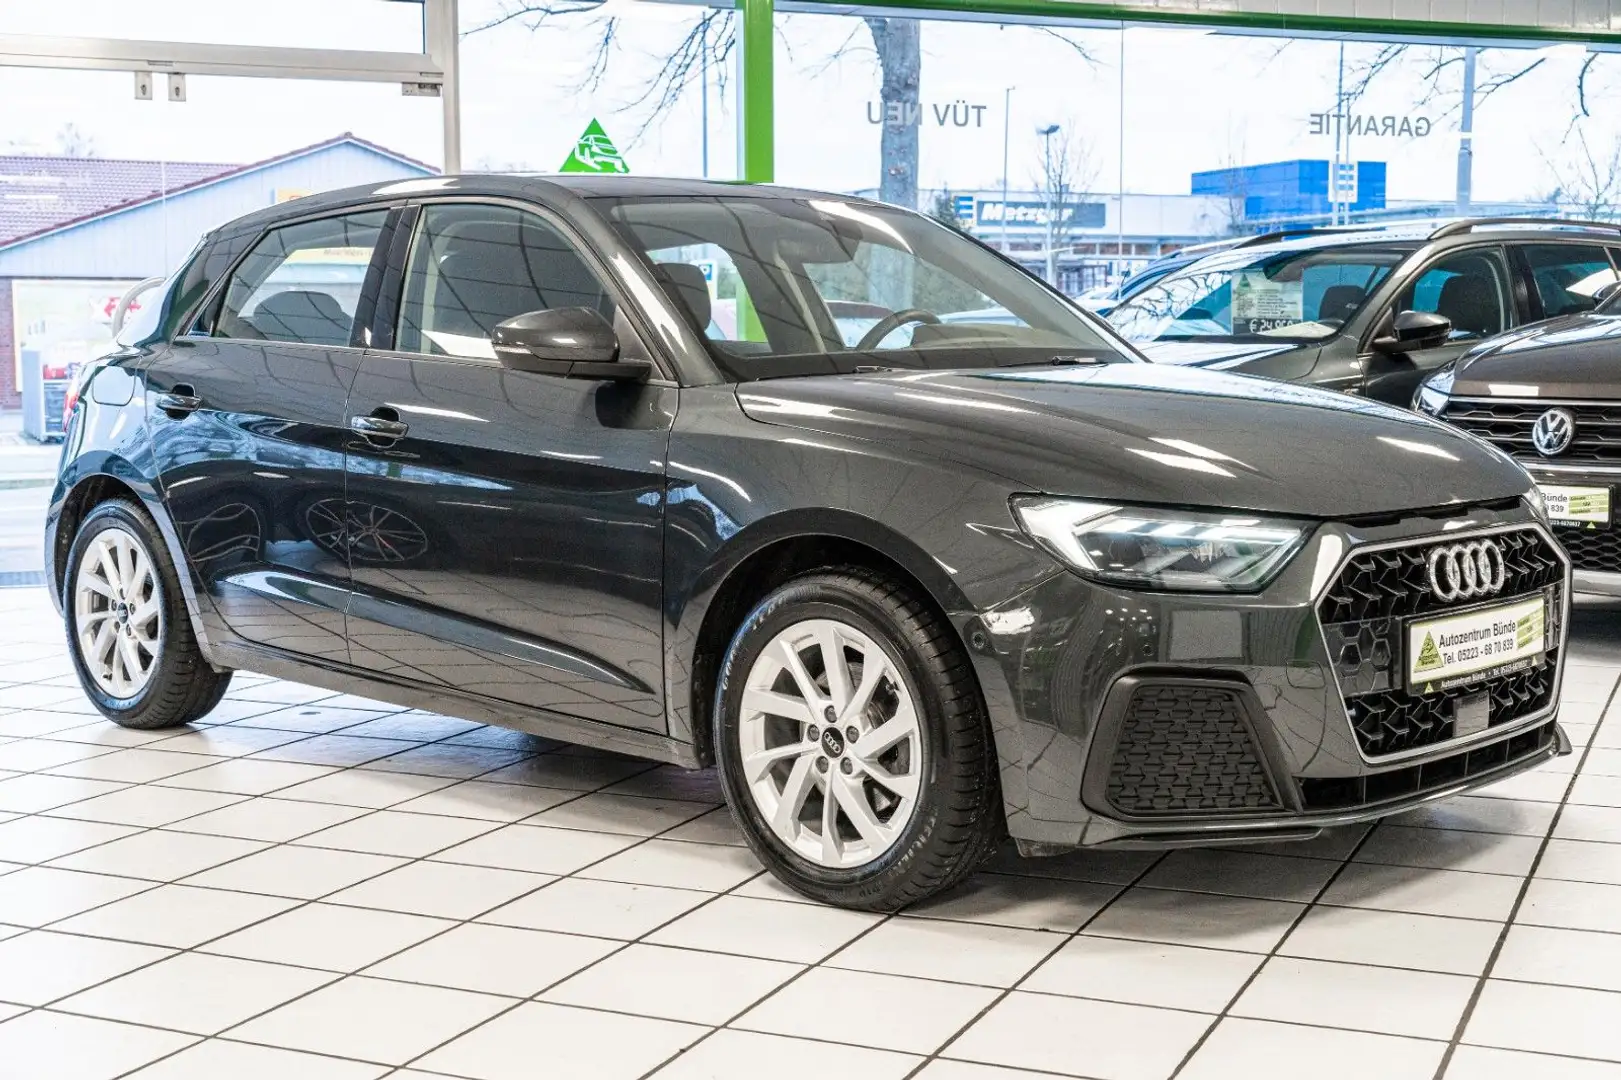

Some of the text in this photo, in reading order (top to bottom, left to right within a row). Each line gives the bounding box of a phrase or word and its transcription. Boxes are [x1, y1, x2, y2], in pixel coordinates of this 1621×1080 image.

[1439, 627, 1491, 648] Autozentrum
[1493, 620, 1516, 636] Bünde
[1443, 652, 1456, 664] Tel.
[1458, 646, 1479, 662] 05223
[1484, 644, 1493, 656] 68
[1494, 641, 1501, 652] 70
[1503, 638, 1514, 651] 839
